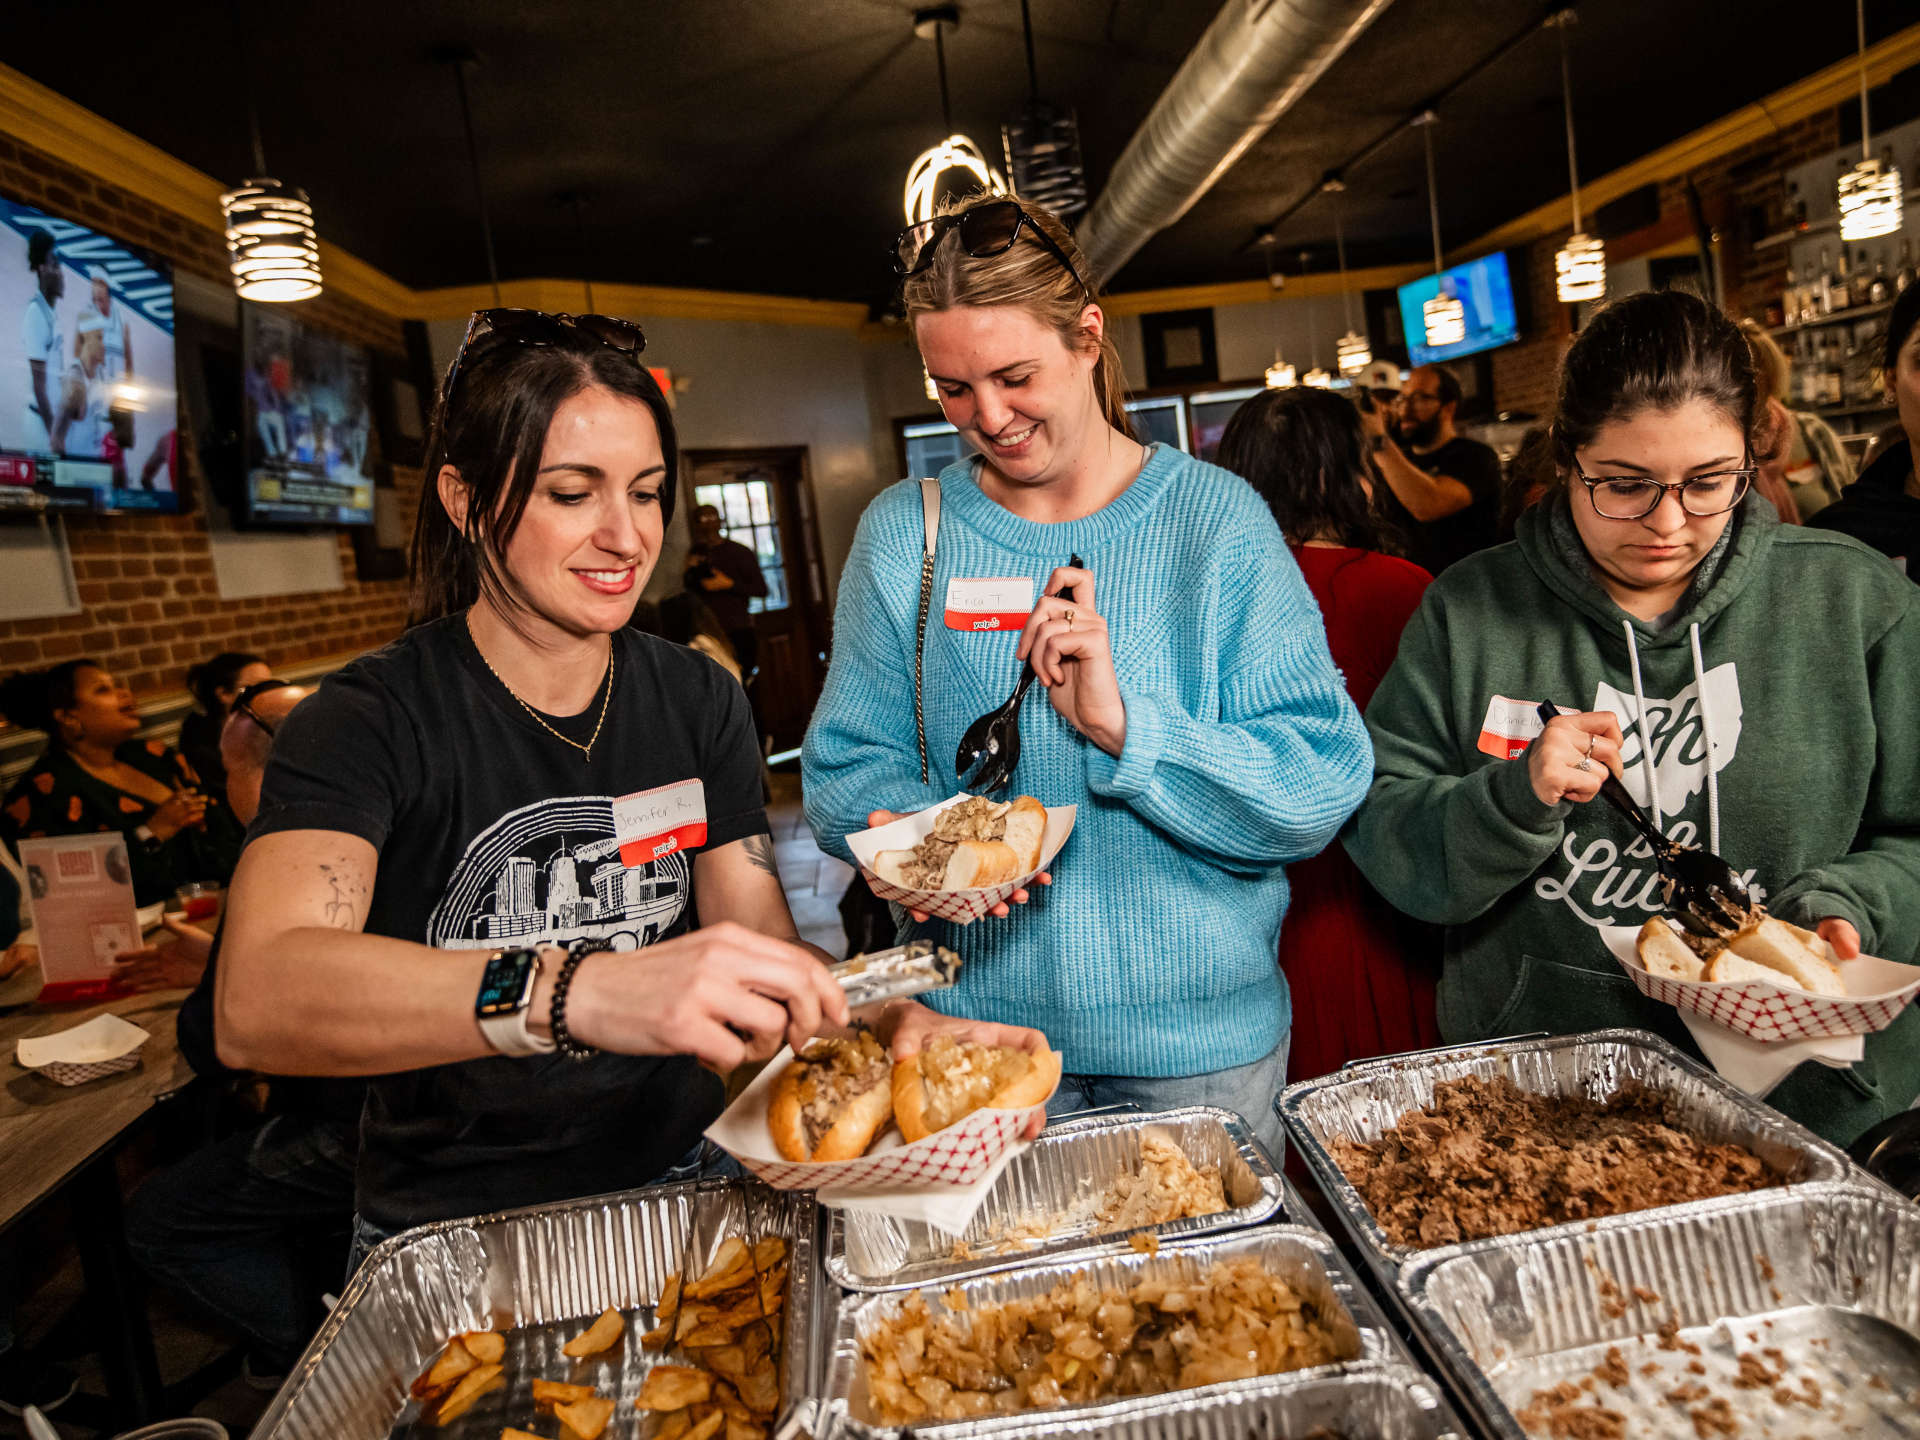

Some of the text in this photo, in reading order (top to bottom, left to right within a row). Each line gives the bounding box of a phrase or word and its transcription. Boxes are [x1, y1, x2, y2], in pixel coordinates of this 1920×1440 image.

[973, 619, 994, 630] yelp
[615, 805, 670, 831] Jennifer
[653, 842, 672, 857] yelp
